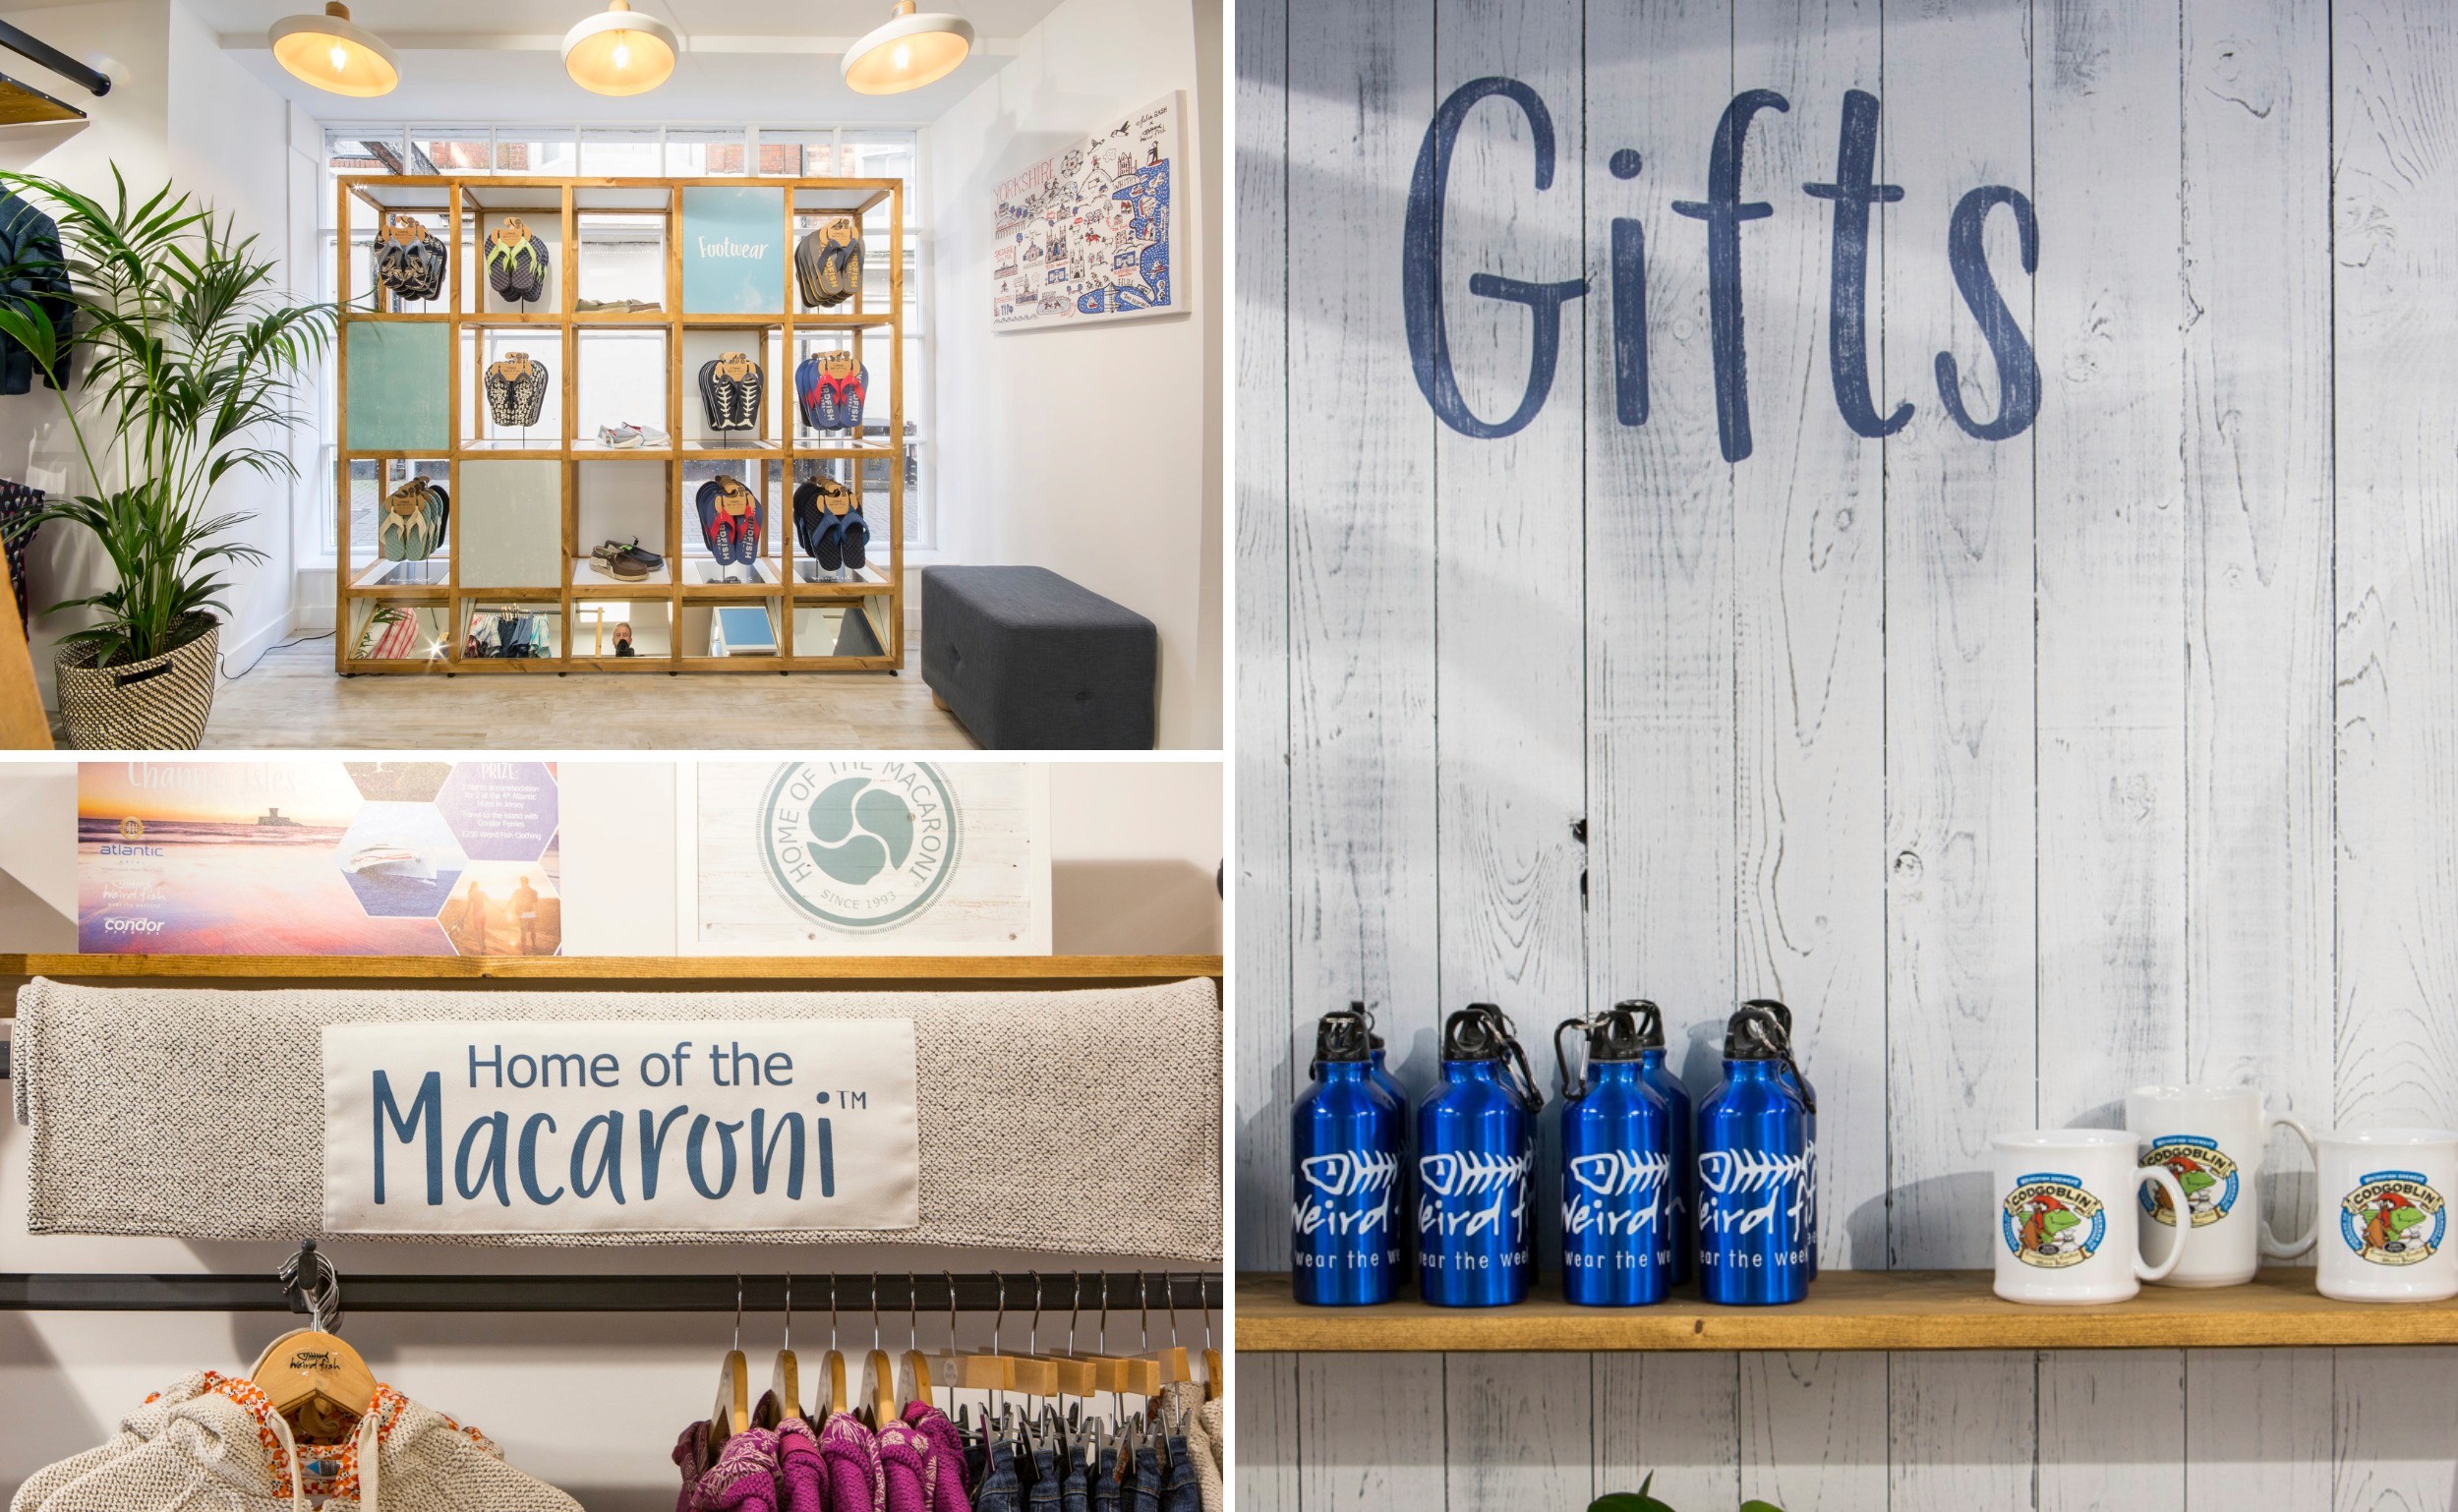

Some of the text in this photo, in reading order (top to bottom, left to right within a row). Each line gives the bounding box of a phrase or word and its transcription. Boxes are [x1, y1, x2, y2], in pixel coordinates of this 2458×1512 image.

[993, 157, 1055, 204] YORKSHIRE
[698, 235, 769, 261] Footwear
[1403, 76, 2042, 462] Gifts
[790, 768, 819, 803] OF
[99, 843, 164, 857] atlantic
[778, 807, 813, 883] HOME
[141, 886, 166, 901] fish
[820, 888, 897, 910] SINCE 1993
[104, 916, 165, 932] condor
[468, 1041, 794, 1089] Home of the
[372, 1069, 836, 1207] Macaroni
[2147, 1147, 2226, 1168] CODGOBLIN
[2012, 1186, 2092, 1207] CODGOBLIN
[2353, 1183, 2435, 1204] CODGOBLIN
[1418, 1187, 1504, 1237] eird
[1698, 1186, 1781, 1235] eird
[1295, 1250, 1337, 1269] wear
[1347, 1250, 1379, 1269] the
[1420, 1250, 1445, 1269] ear
[1455, 1250, 1489, 1270] the
[1564, 1250, 1606, 1269] wear
[1615, 1250, 1648, 1269] the
[1728, 1250, 1762, 1268] the
[319, 1357, 341, 1371] fish
